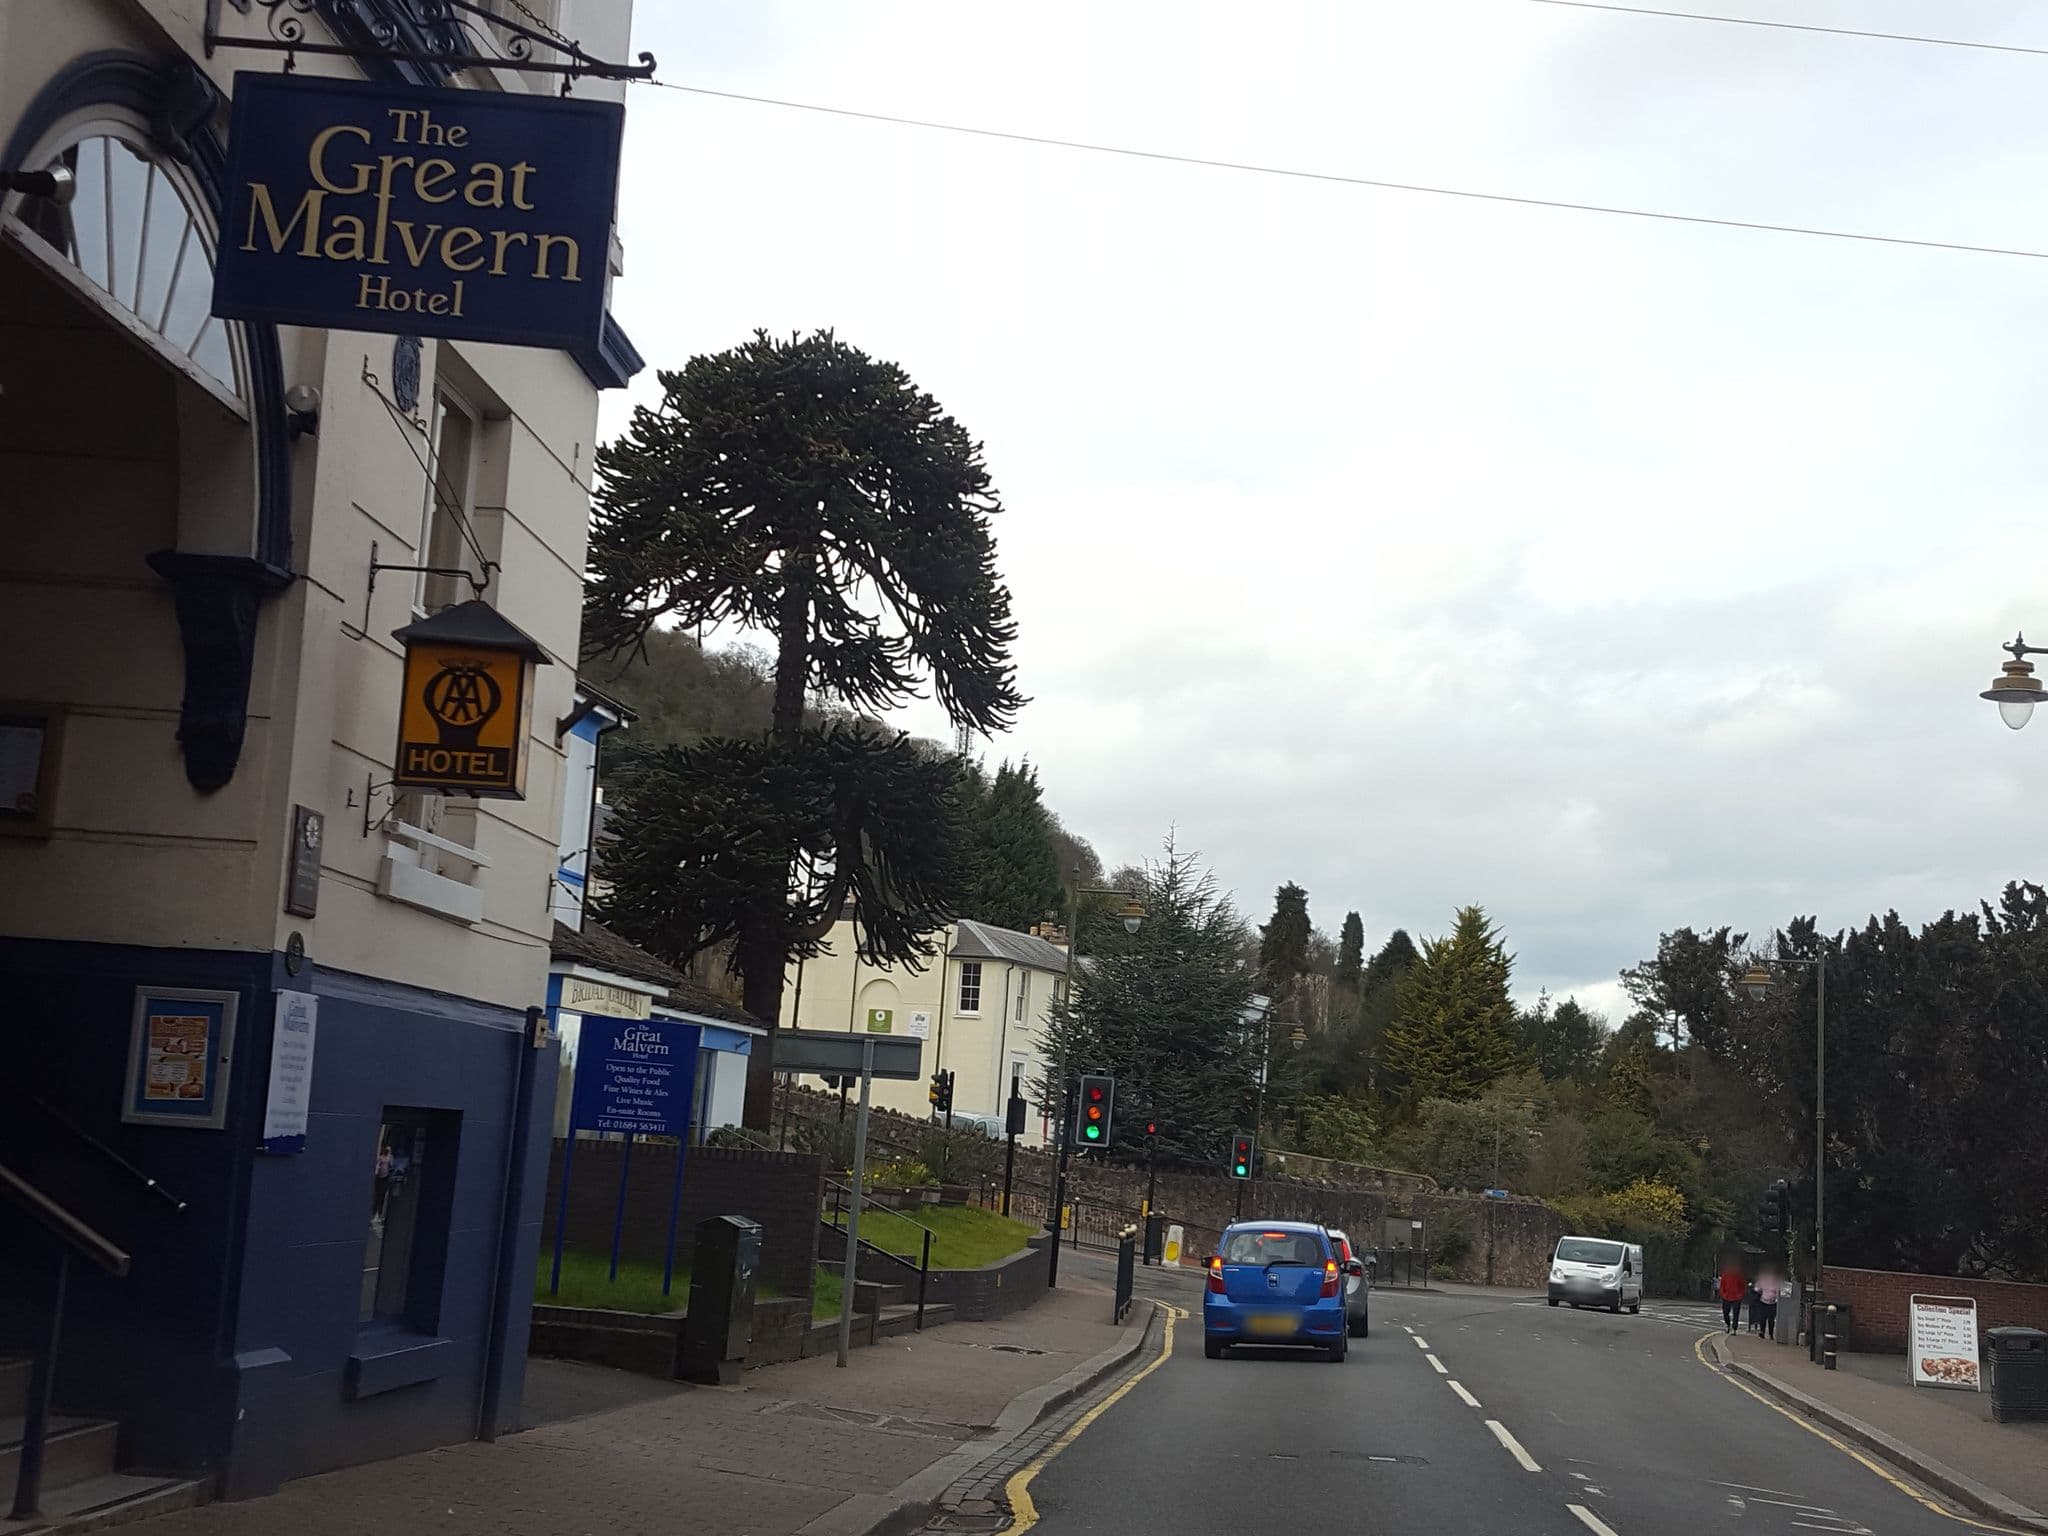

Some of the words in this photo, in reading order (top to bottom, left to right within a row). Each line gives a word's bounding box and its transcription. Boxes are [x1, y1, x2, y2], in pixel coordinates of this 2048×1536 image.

[388, 109, 469, 147] The
[308, 125, 537, 211] Great
[239, 182, 583, 283] Malvern
[355, 273, 465, 317] Hotel
[439, 673, 485, 722] AA
[408, 749, 504, 776] HOTEL
[624, 1027, 662, 1043] Great
[613, 1037, 669, 1055] Malvern
[606, 1063, 626, 1073] Open
[649, 1067, 672, 1076] Public
[614, 1075, 640, 1085] Quality
[642, 1077, 661, 1086] Food
[603, 1084, 620, 1093] Fine
[621, 1086, 643, 1095] Wines
[644, 1088, 653, 1096] &
[654, 1089, 669, 1097] Ales
[616, 1096, 631, 1105] Live
[633, 1098, 654, 1106] Music
[637, 1108, 662, 1117] Rooms
[613, 1120, 637, 1130] 01684
